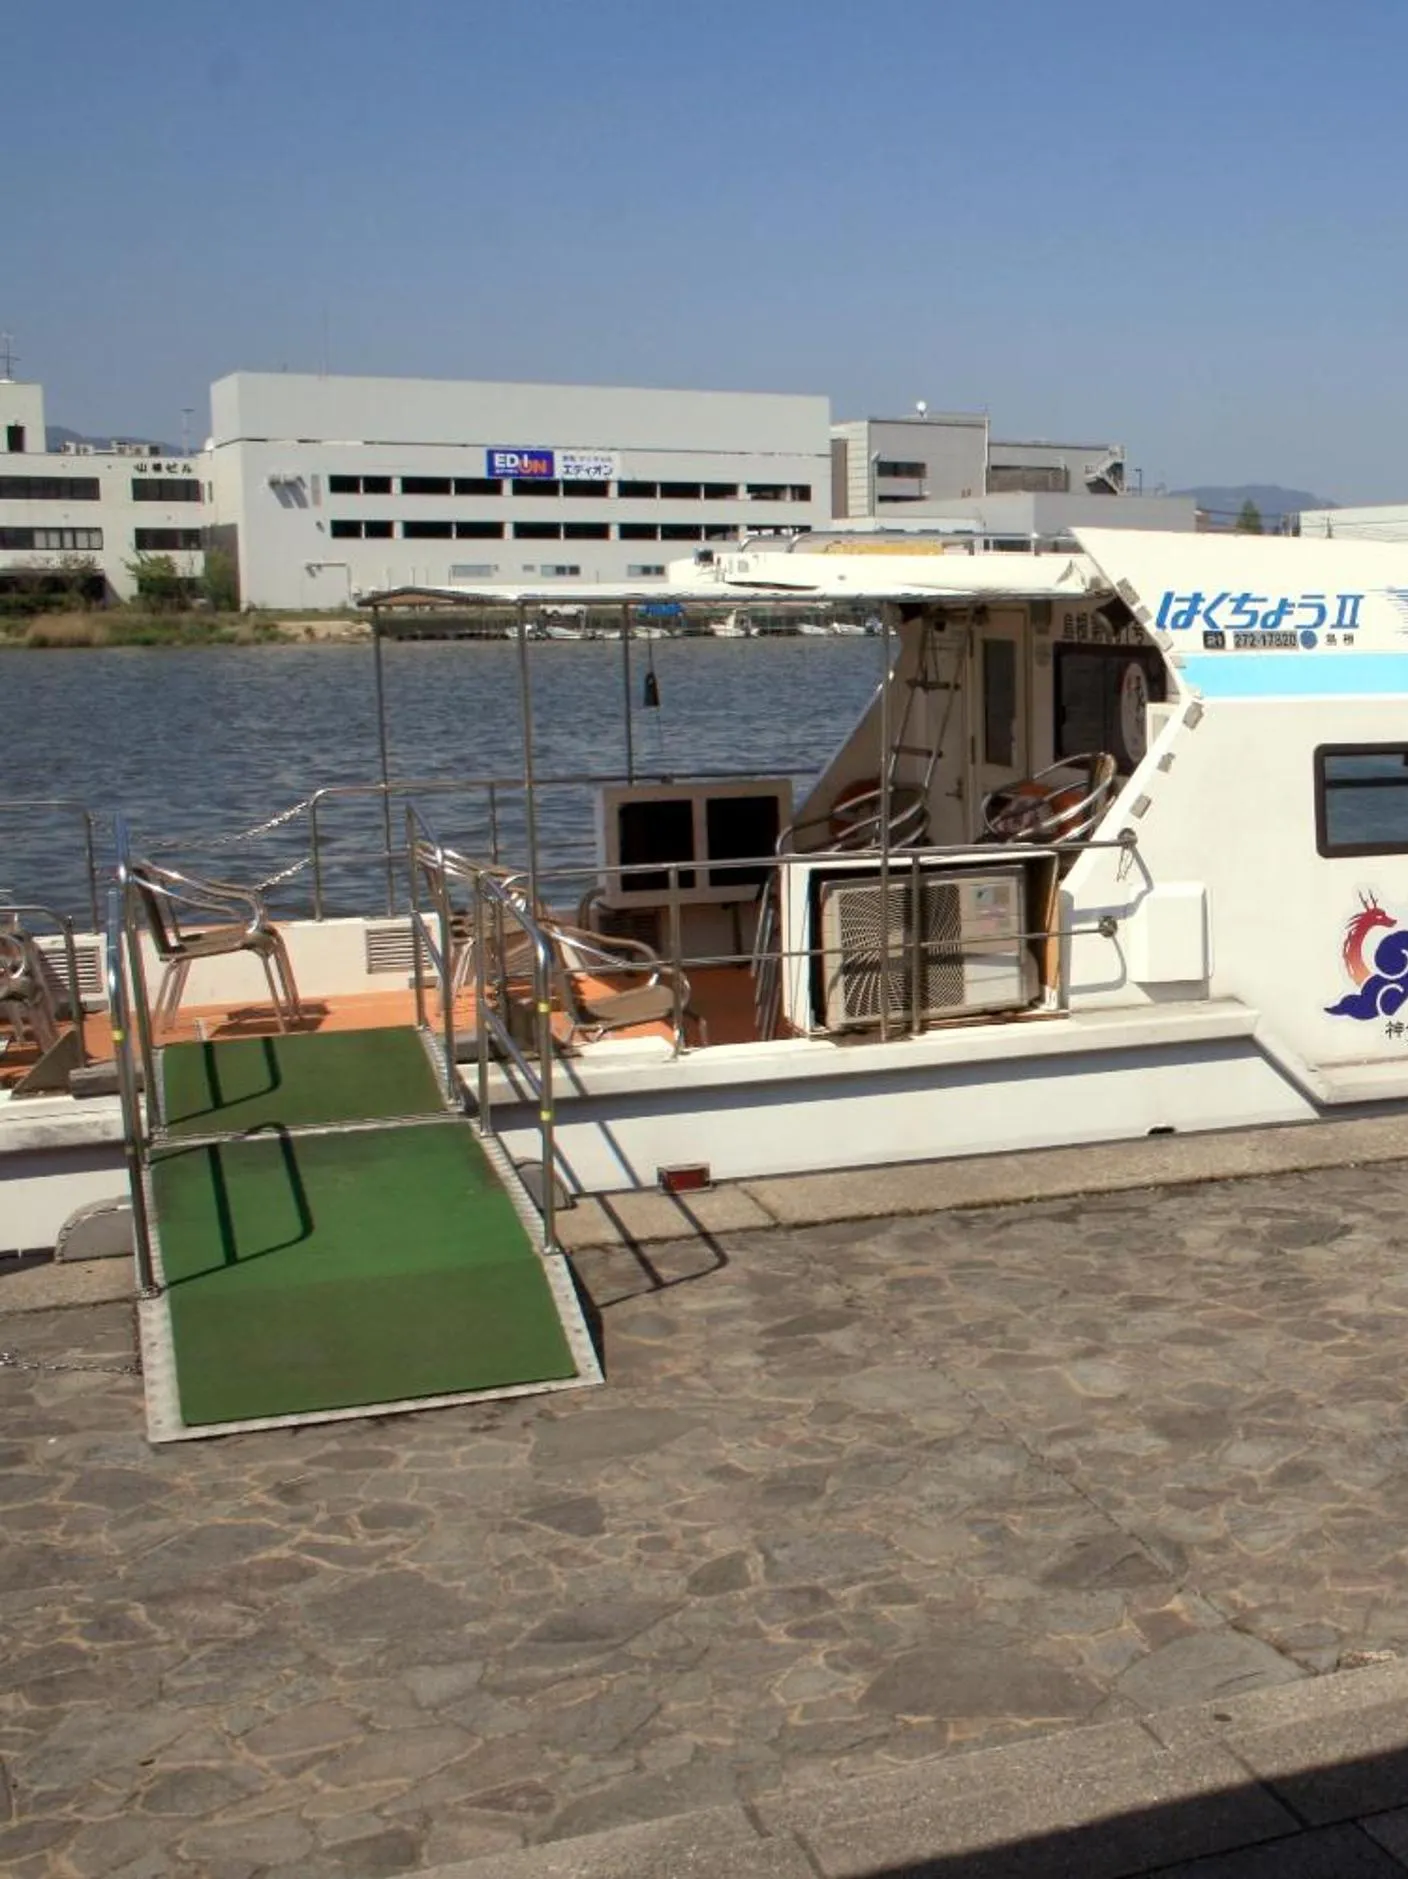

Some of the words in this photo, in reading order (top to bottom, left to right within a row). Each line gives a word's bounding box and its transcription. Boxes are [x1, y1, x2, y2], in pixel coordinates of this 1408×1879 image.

[493, 453, 547, 474] EDION
[562, 464, 614, 477] エディオン
